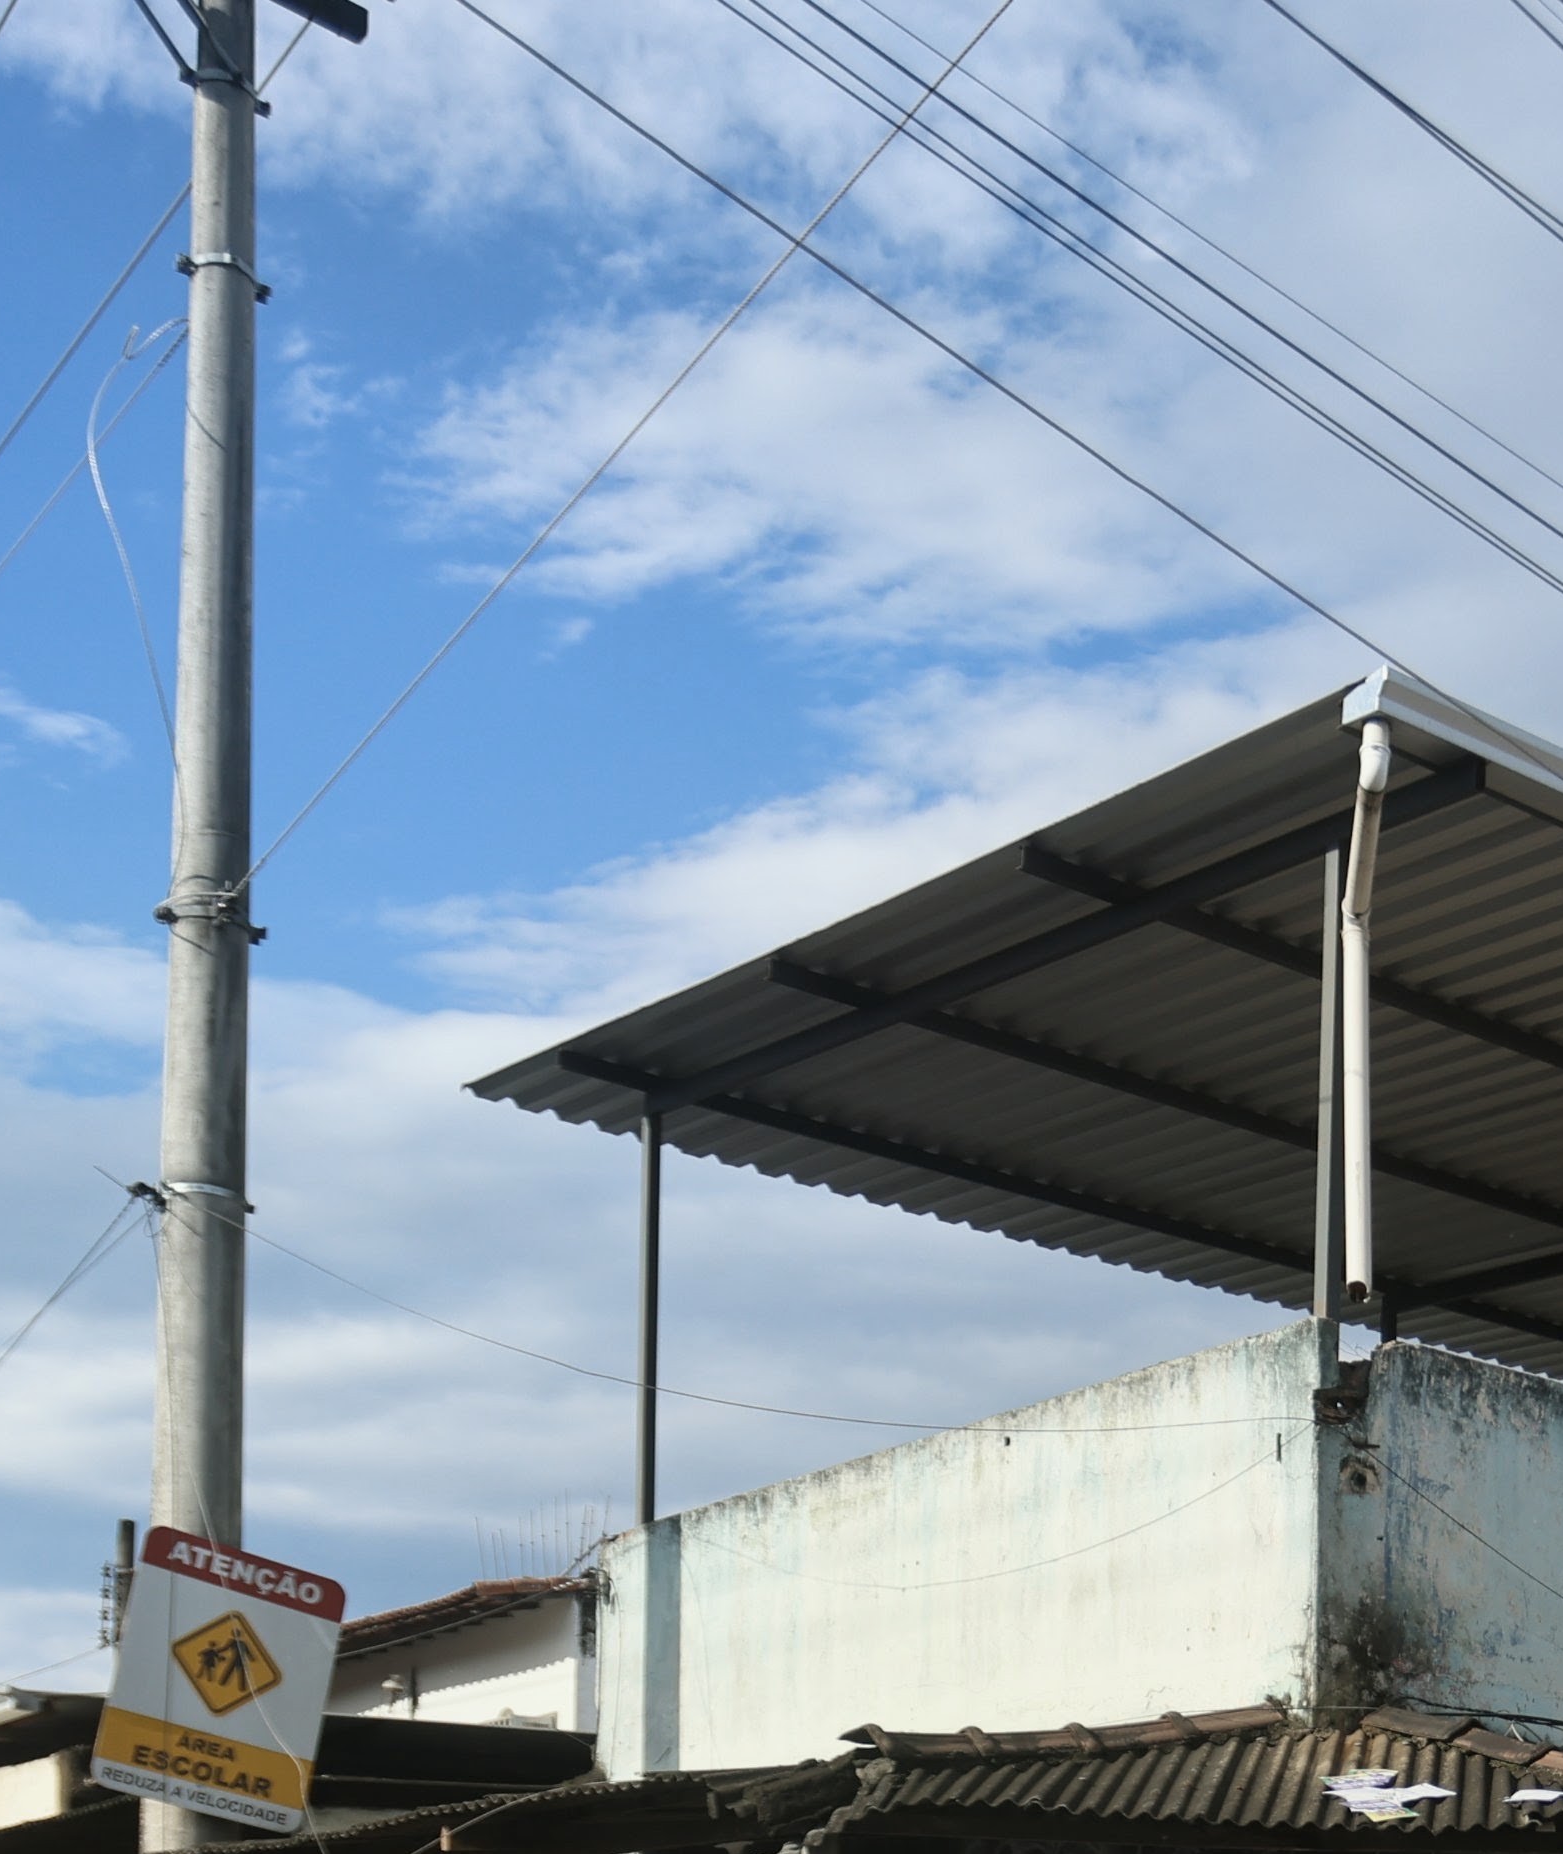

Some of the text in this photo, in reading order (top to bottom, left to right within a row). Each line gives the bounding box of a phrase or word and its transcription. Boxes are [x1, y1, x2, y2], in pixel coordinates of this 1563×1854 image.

[168, 1540, 323, 1605] ATENÇÃO
[101, 1766, 288, 1826] REDUZA A VELOCIDADE
[132, 1744, 272, 1798] ESCOLAR
